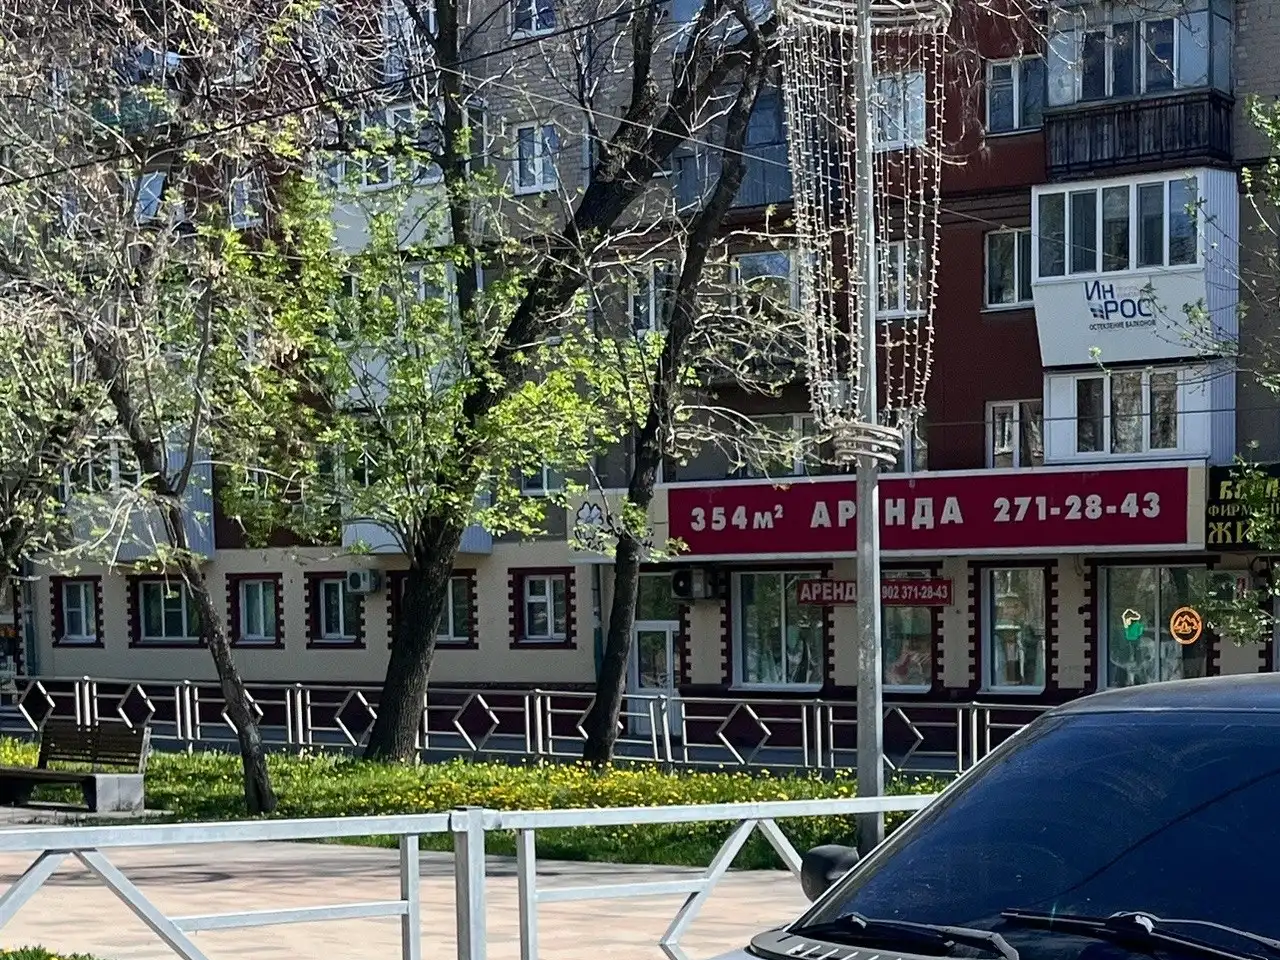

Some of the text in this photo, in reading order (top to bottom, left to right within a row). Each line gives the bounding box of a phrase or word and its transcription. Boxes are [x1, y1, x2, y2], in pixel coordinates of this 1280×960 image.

[1103, 298, 1153, 320] РОС
[810, 496, 965, 530] АРНДА
[993, 491, 1162, 523] 271-28-43
[800, 582, 858, 601] АРЕНД
[901, 584, 949, 600] 371-28-43
